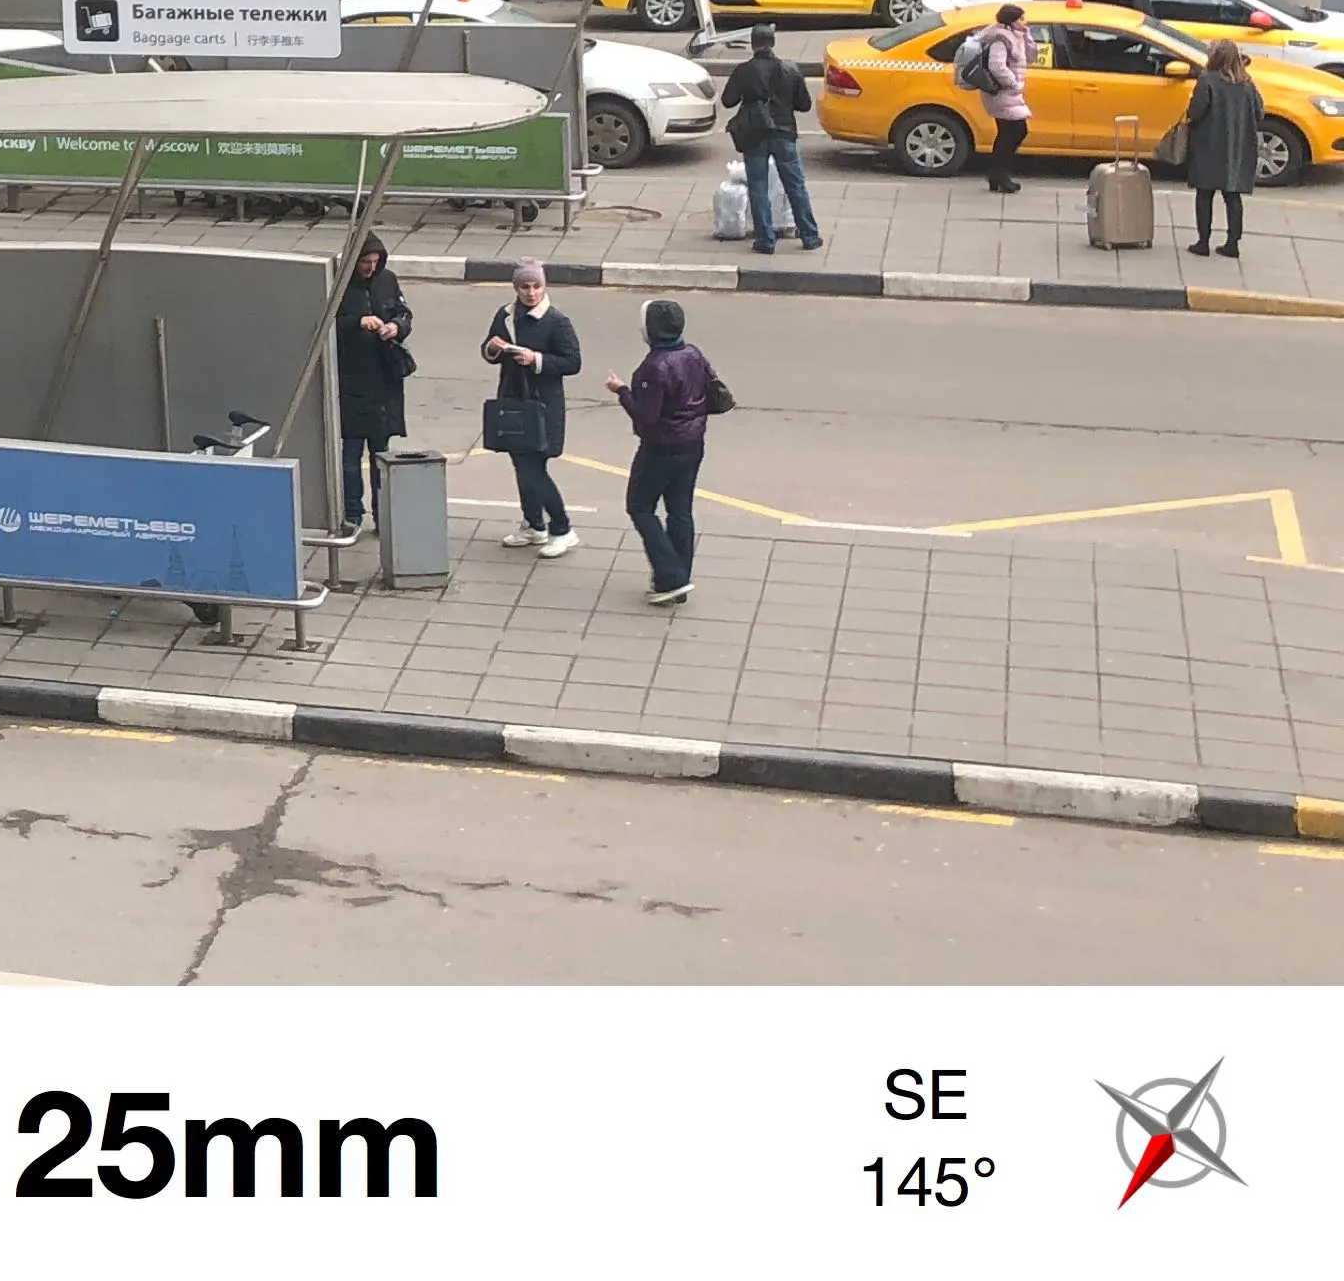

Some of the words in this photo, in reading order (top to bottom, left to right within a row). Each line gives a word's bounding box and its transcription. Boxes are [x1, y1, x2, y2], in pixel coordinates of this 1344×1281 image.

[132, 4, 234, 21] Багажные
[239, 6, 327, 22] тележки
[133, 31, 191, 46] Baggage
[194, 31, 226, 45] carts
[56, 136, 120, 151] Welcome
[217, 141, 303, 156] 欢迎来到莫斯科
[28, 512, 196, 534] ШЕРЕМЕТЬЕВО
